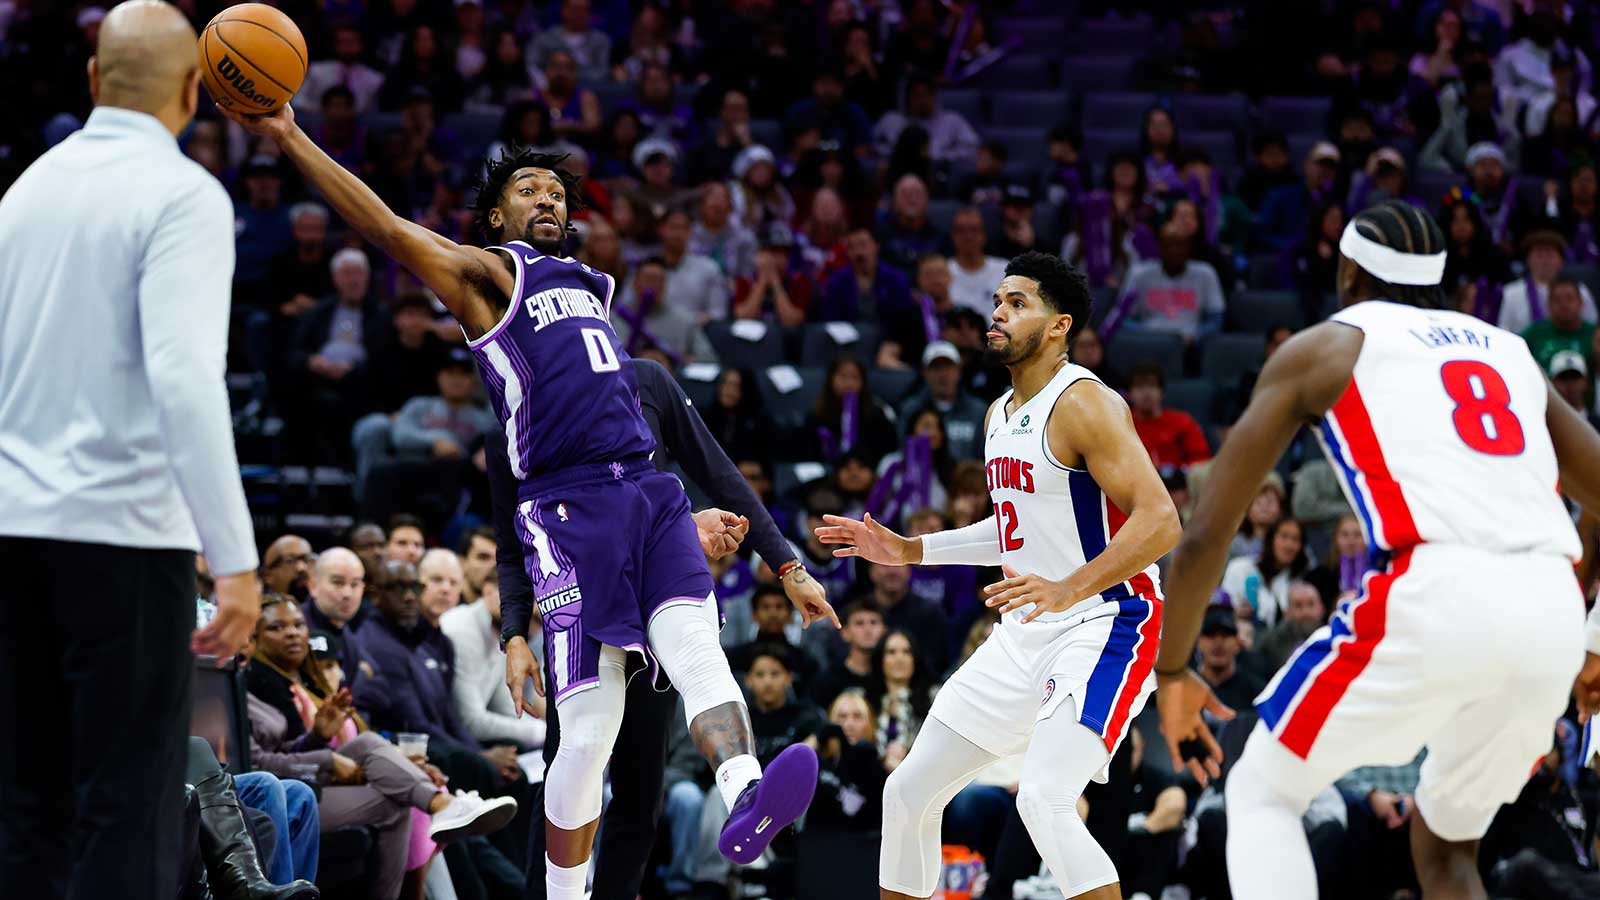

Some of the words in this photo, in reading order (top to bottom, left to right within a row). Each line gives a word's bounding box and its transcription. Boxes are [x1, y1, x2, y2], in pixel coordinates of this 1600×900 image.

[217, 53, 277, 108] Wilson
[525, 287, 611, 333] SACRAMEN
[581, 328, 620, 373] 0
[1440, 359, 1525, 456] 8
[985, 456, 1035, 493] STONS
[993, 500, 1025, 554] 12
[538, 587, 582, 616] KINGS
